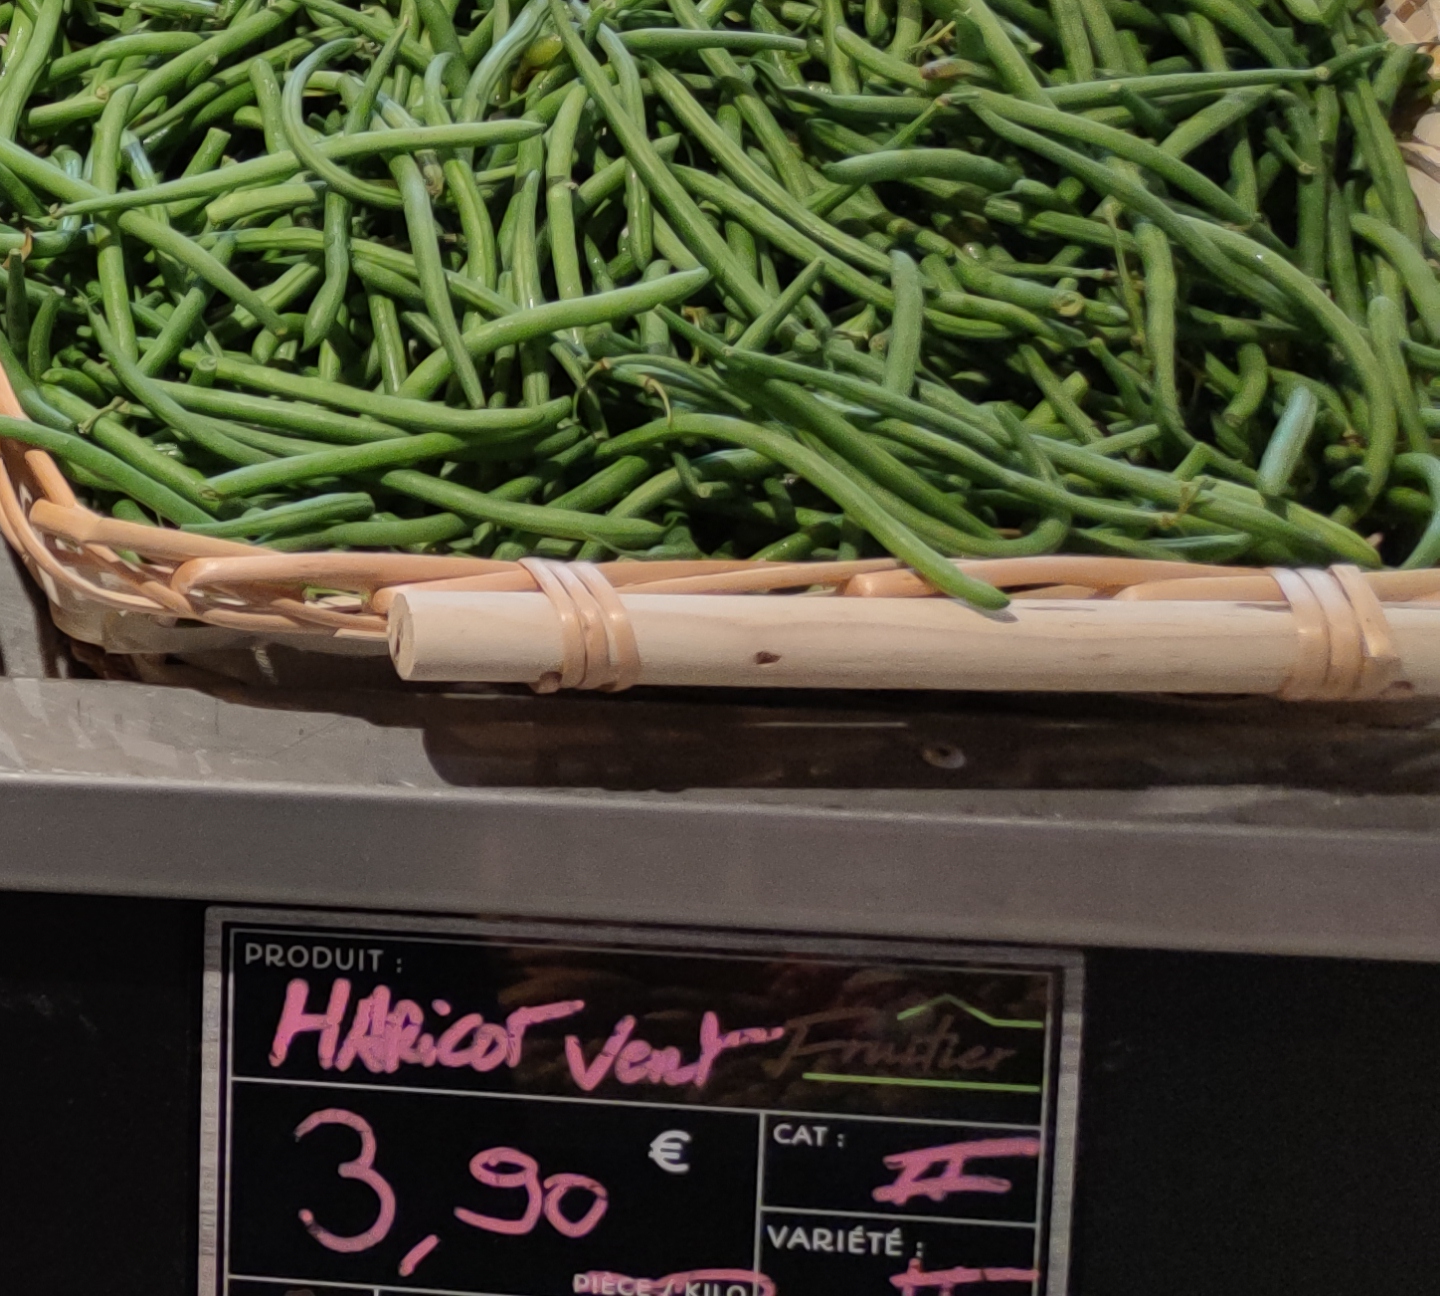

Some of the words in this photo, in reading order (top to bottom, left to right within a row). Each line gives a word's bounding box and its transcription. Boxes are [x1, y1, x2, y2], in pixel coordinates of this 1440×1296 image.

[244, 943, 386, 974] PRODUIT
[773, 1123, 830, 1149] CAT
[295, 1108, 610, 1278] 3,90
[648, 1130, 692, 1173] €
[767, 1225, 902, 1257] VARIÉTÉ
